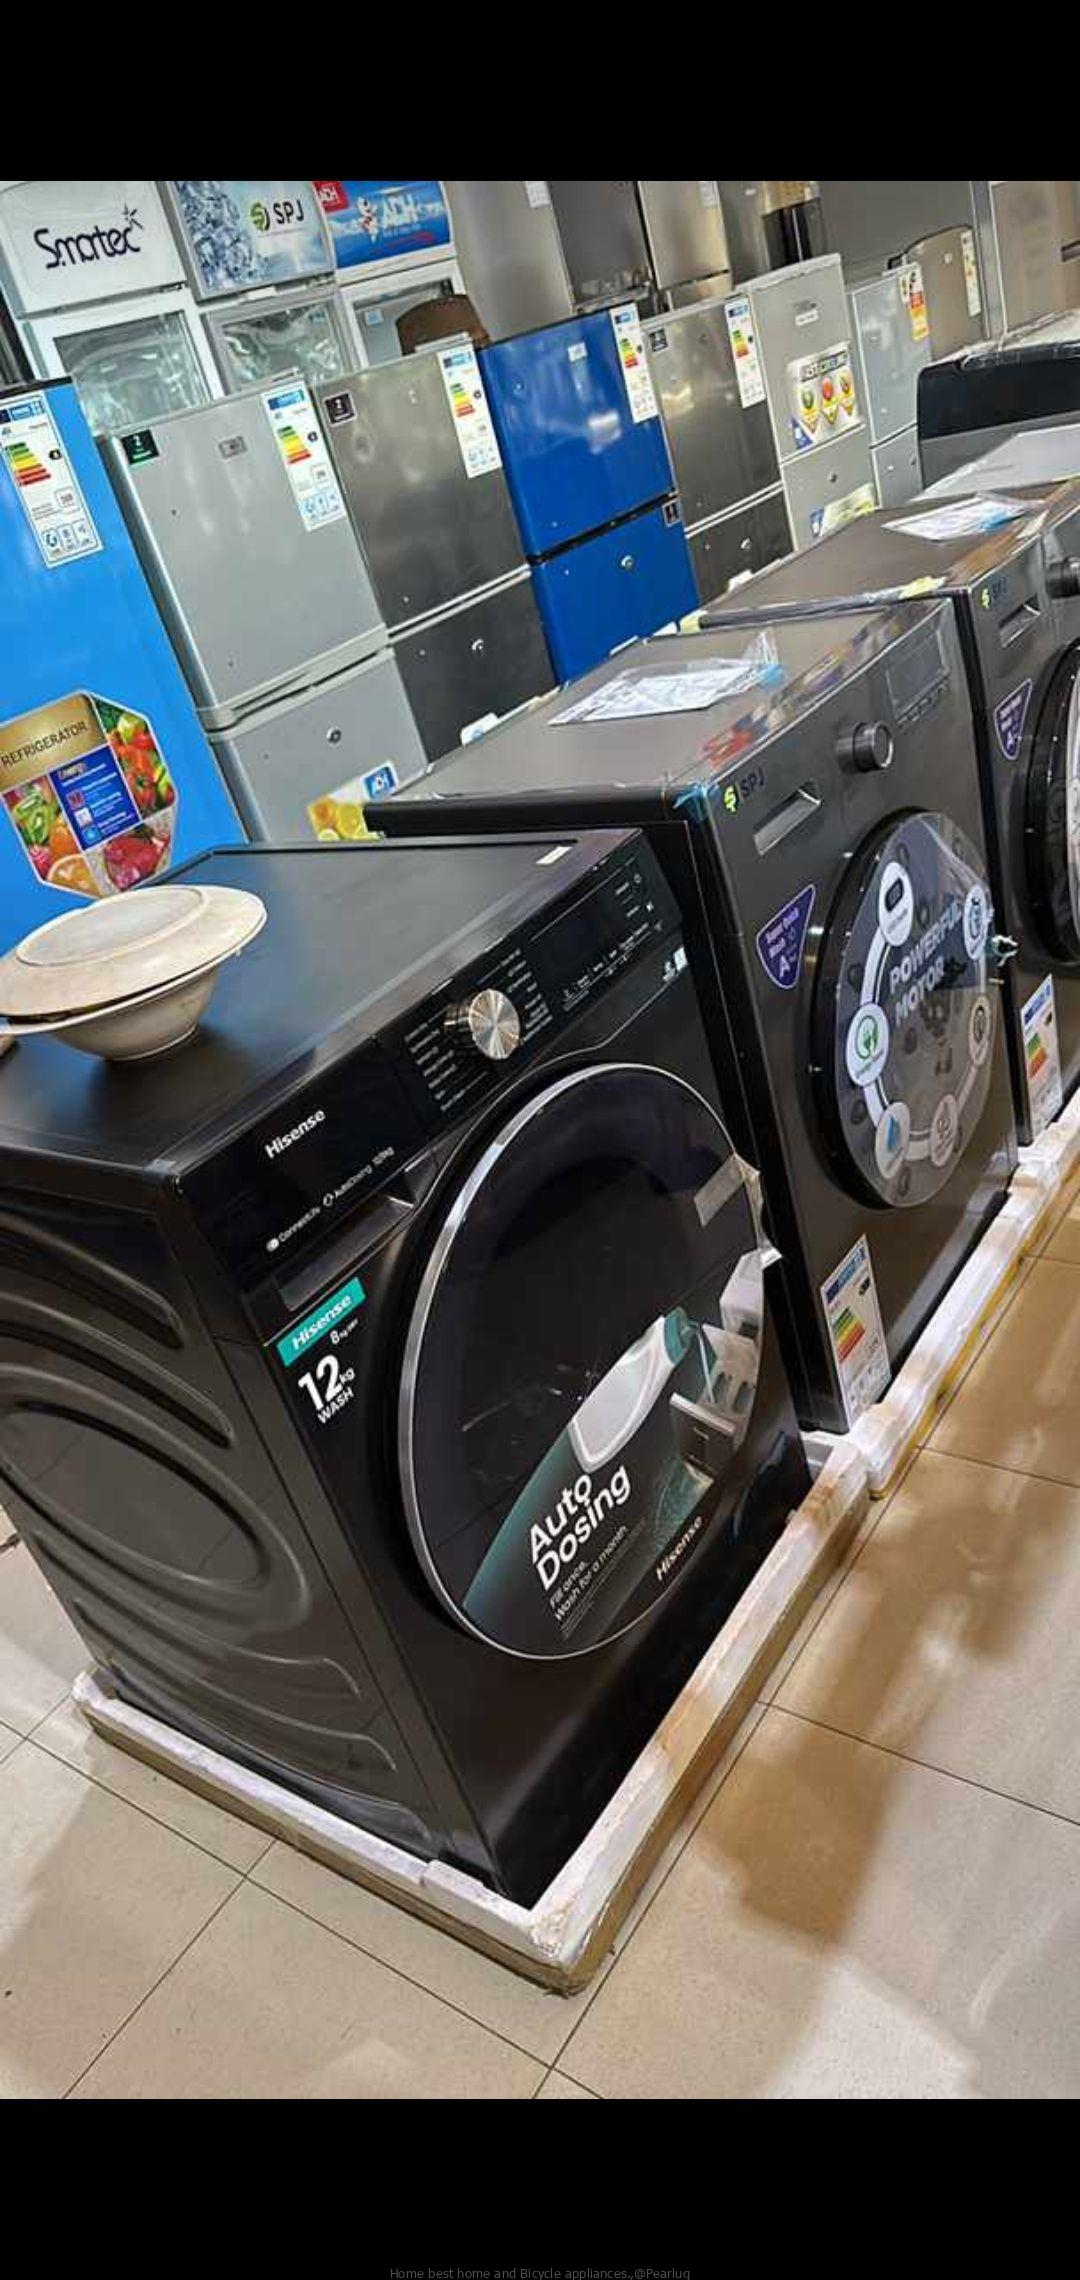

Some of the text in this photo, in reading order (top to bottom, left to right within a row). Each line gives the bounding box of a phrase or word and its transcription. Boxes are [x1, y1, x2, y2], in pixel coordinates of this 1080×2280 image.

[273, 198, 305, 225] SPJ
[1, 719, 88, 768] REFRIGERATOR
[264, 1109, 327, 1160] Hisense
[291, 1295, 354, 1350] Hisense
[316, 1386, 355, 1424] WASH
[529, 1473, 593, 1565] Auto
[536, 1464, 632, 1591] Dosing
[655, 1515, 703, 1581] Hisense
